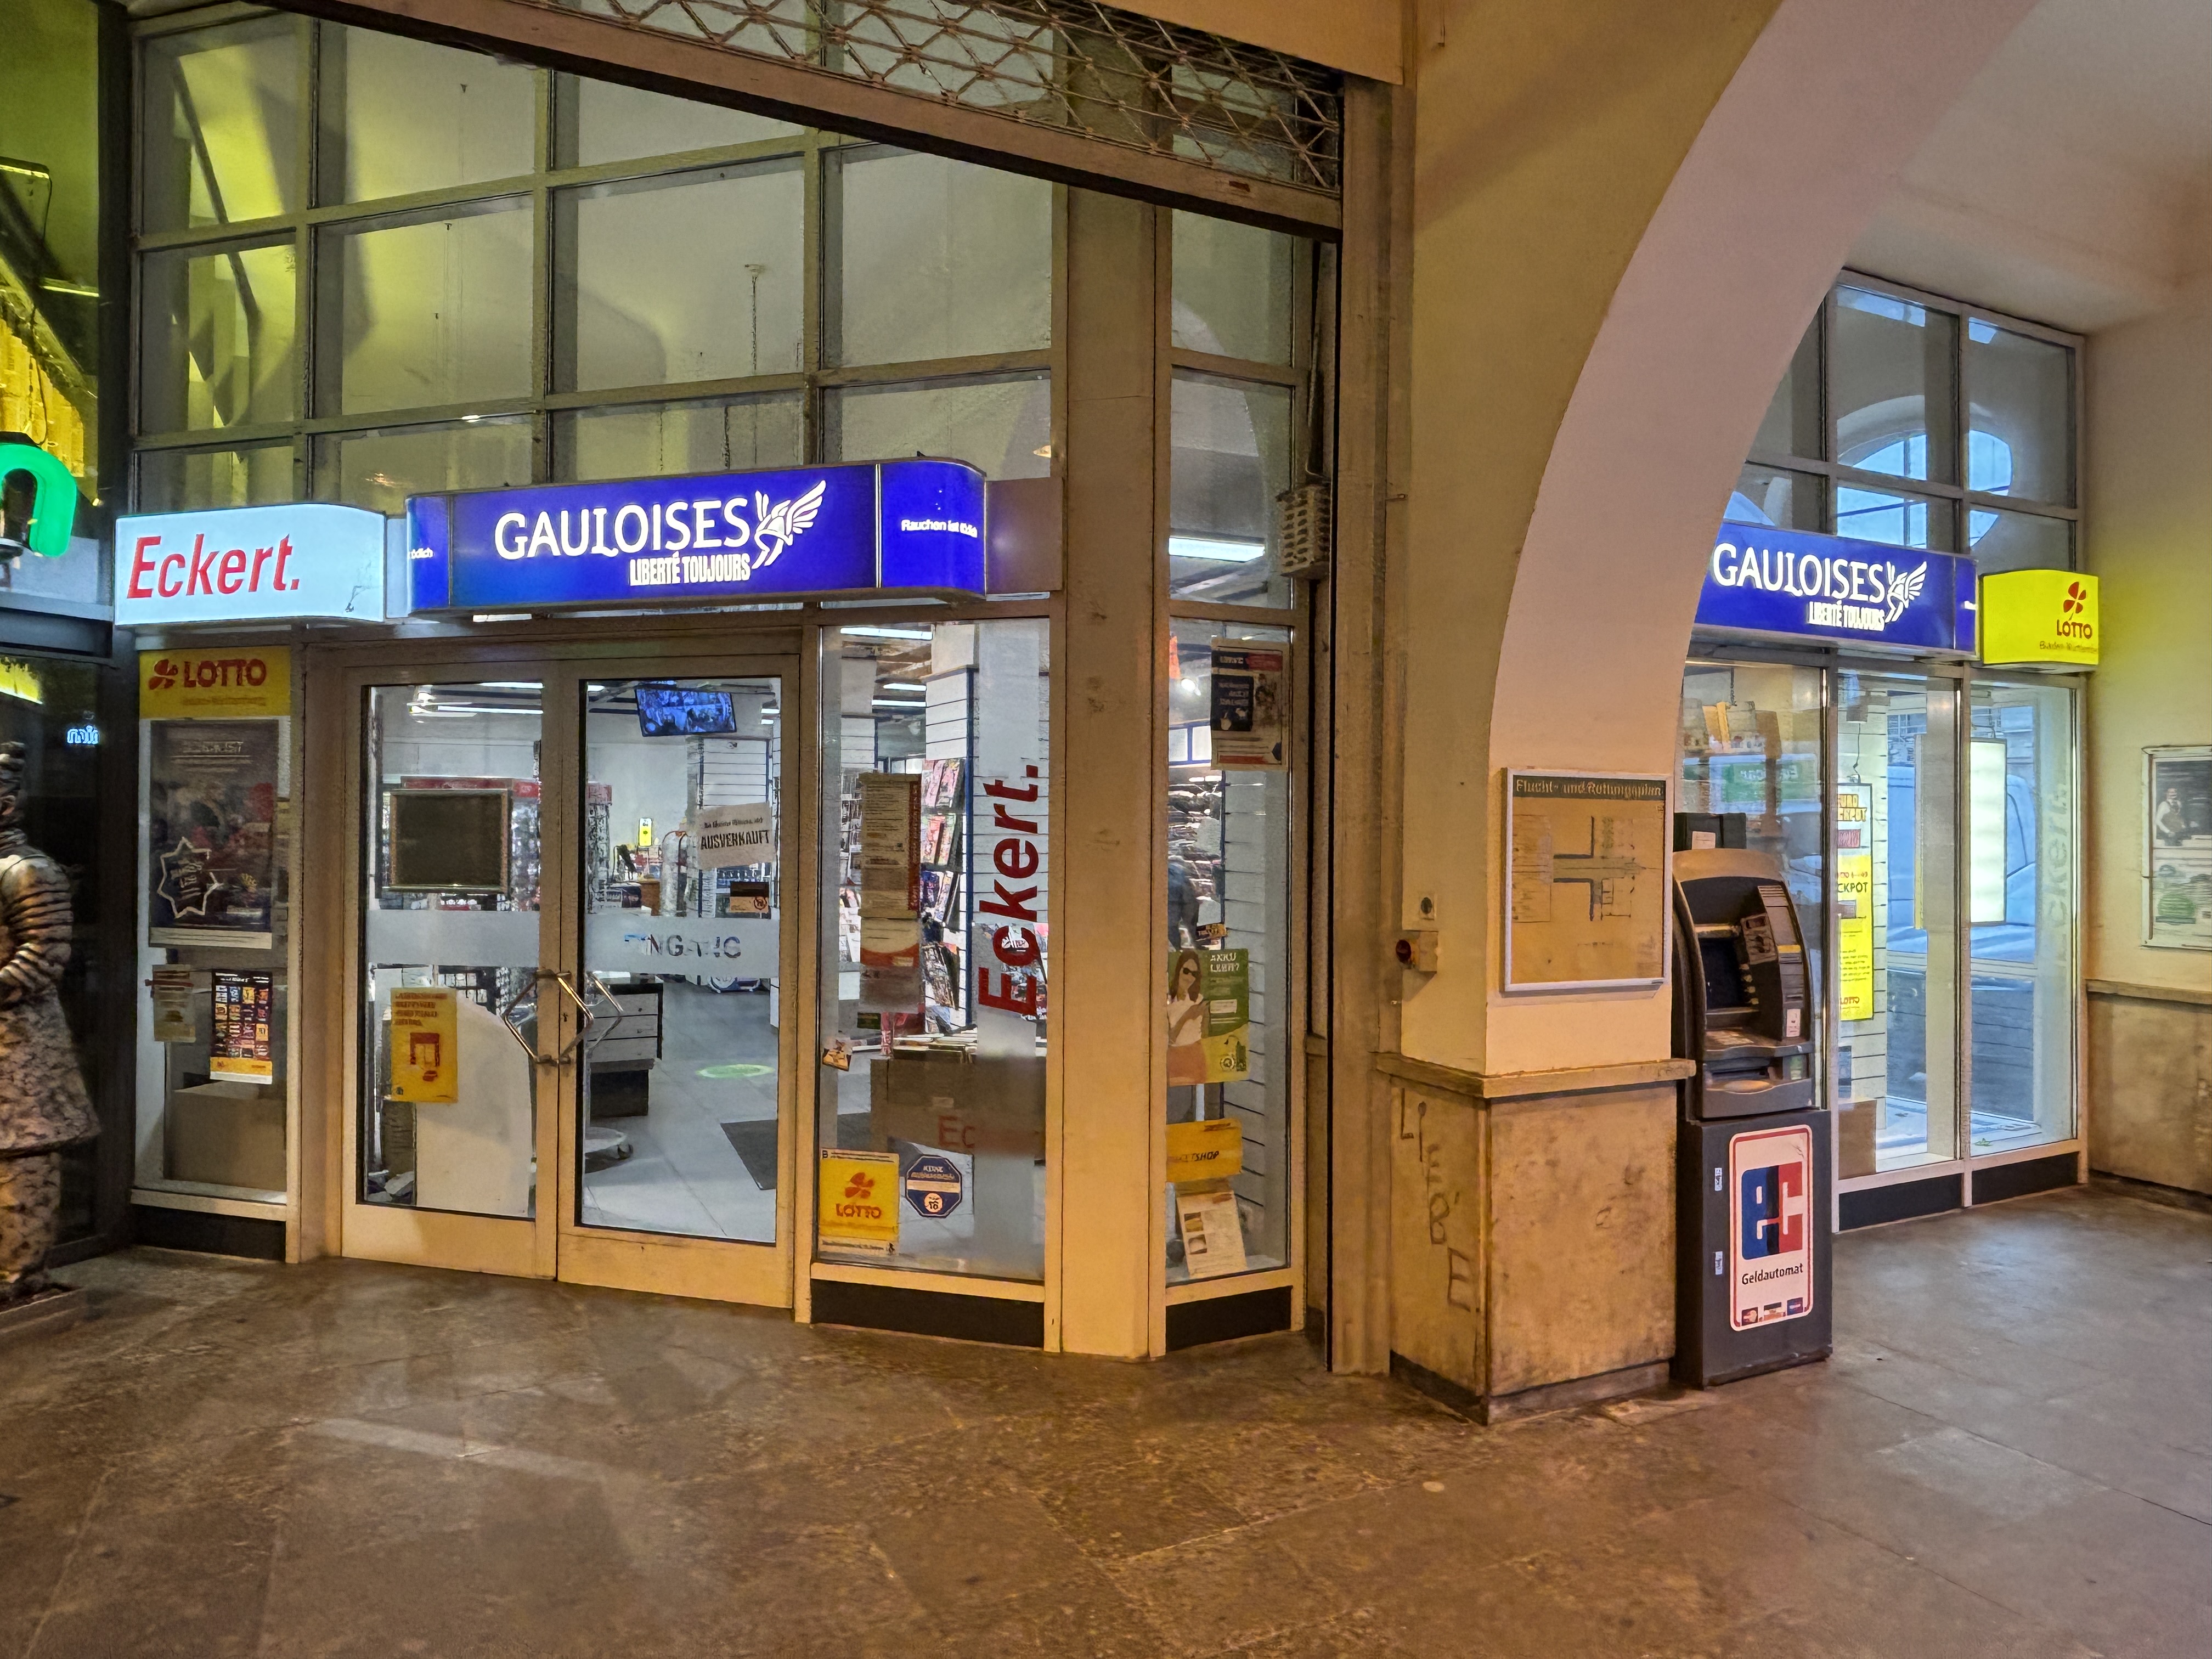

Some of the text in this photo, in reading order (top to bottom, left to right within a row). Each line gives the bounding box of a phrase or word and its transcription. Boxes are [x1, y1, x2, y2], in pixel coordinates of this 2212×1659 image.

[494, 496, 751, 560] GAULOISES
[901, 518, 947, 531] Rauchen
[126, 533, 301, 599] Eckert.
[629, 551, 751, 586] LIBERTÉ TOUJOURS
[1712, 543, 1887, 604] GAULOISES
[1808, 600, 1885, 631] LIBERTÉ TOUJOURS
[2056, 619, 2093, 640] LOTTO
[183, 658, 267, 688] LOTTO
[978, 764, 1039, 1016] Eckert.
[1838, 882, 1869, 893] CKPOT
[835, 1203, 882, 1220] LOTTO
[1741, 1262, 1804, 1285] Geldautomat
